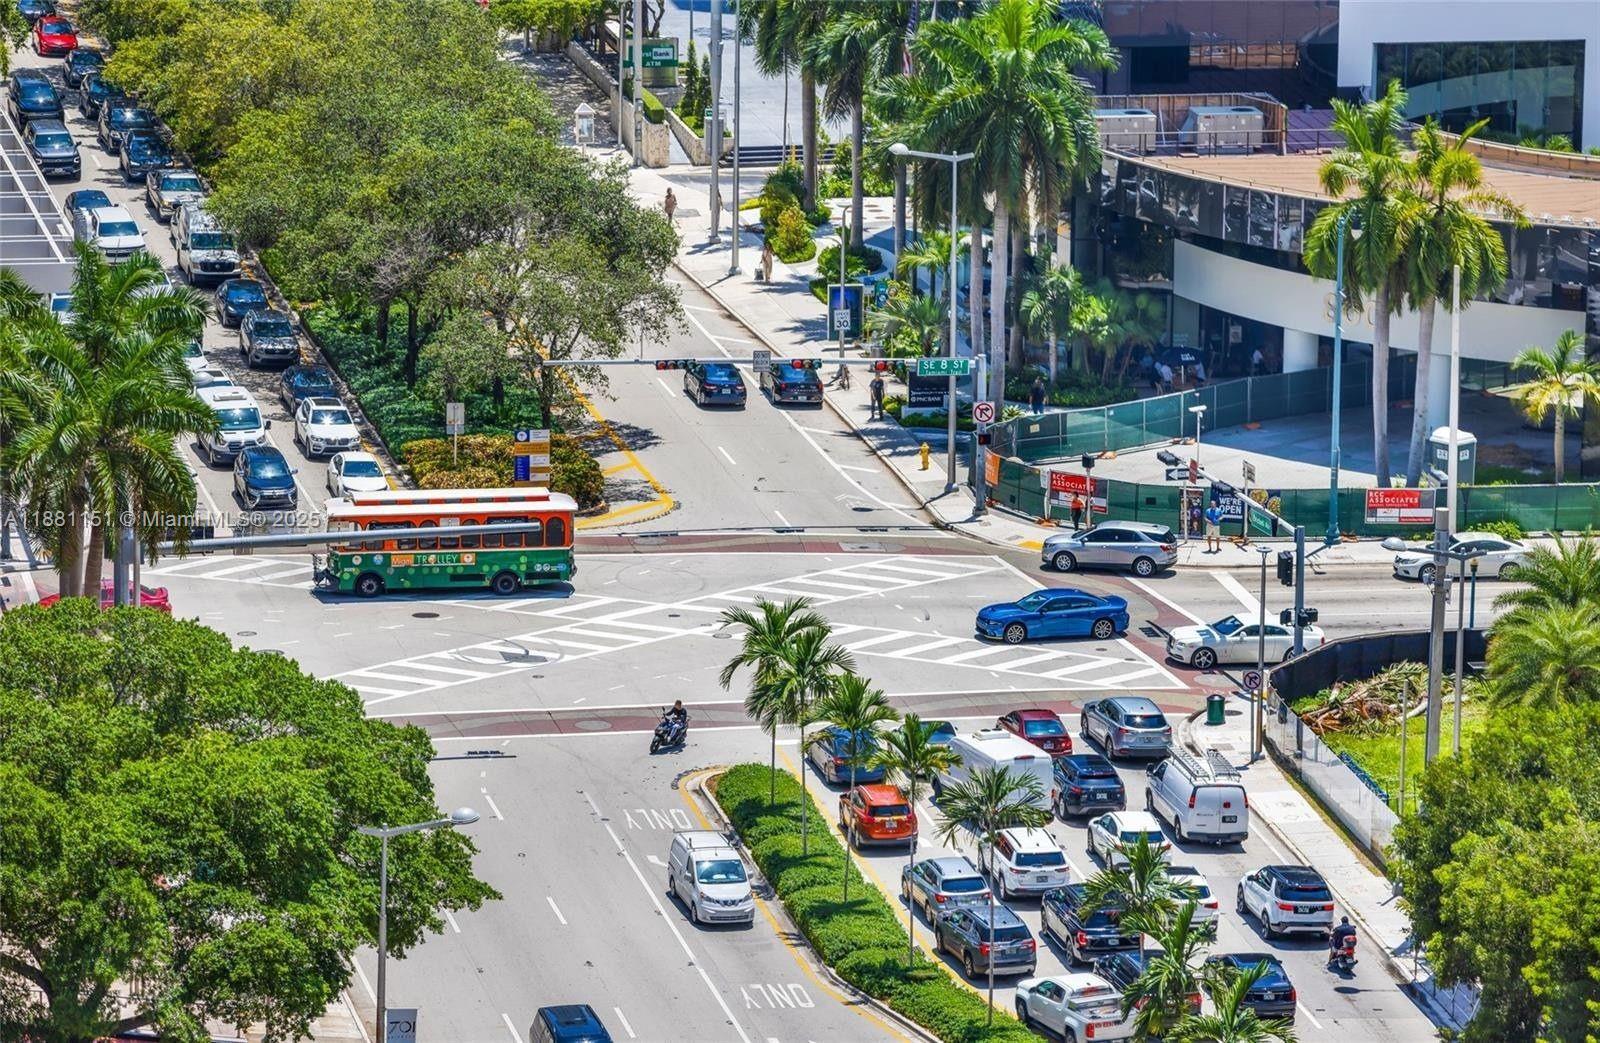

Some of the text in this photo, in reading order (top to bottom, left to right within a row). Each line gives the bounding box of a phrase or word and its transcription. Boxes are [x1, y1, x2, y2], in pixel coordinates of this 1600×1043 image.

[836, 320, 849, 328] 30
[923, 360, 964, 370] SE 8 ST
[1052, 479, 1095, 492] ASSOCIATS
[1219, 496, 1242, 506] WE'RE
[1219, 505, 1242, 514] OPEN
[622, 808, 693, 830] ONLY
[740, 983, 816, 1009] ONLY
[388, 1020, 416, 1034] 701
